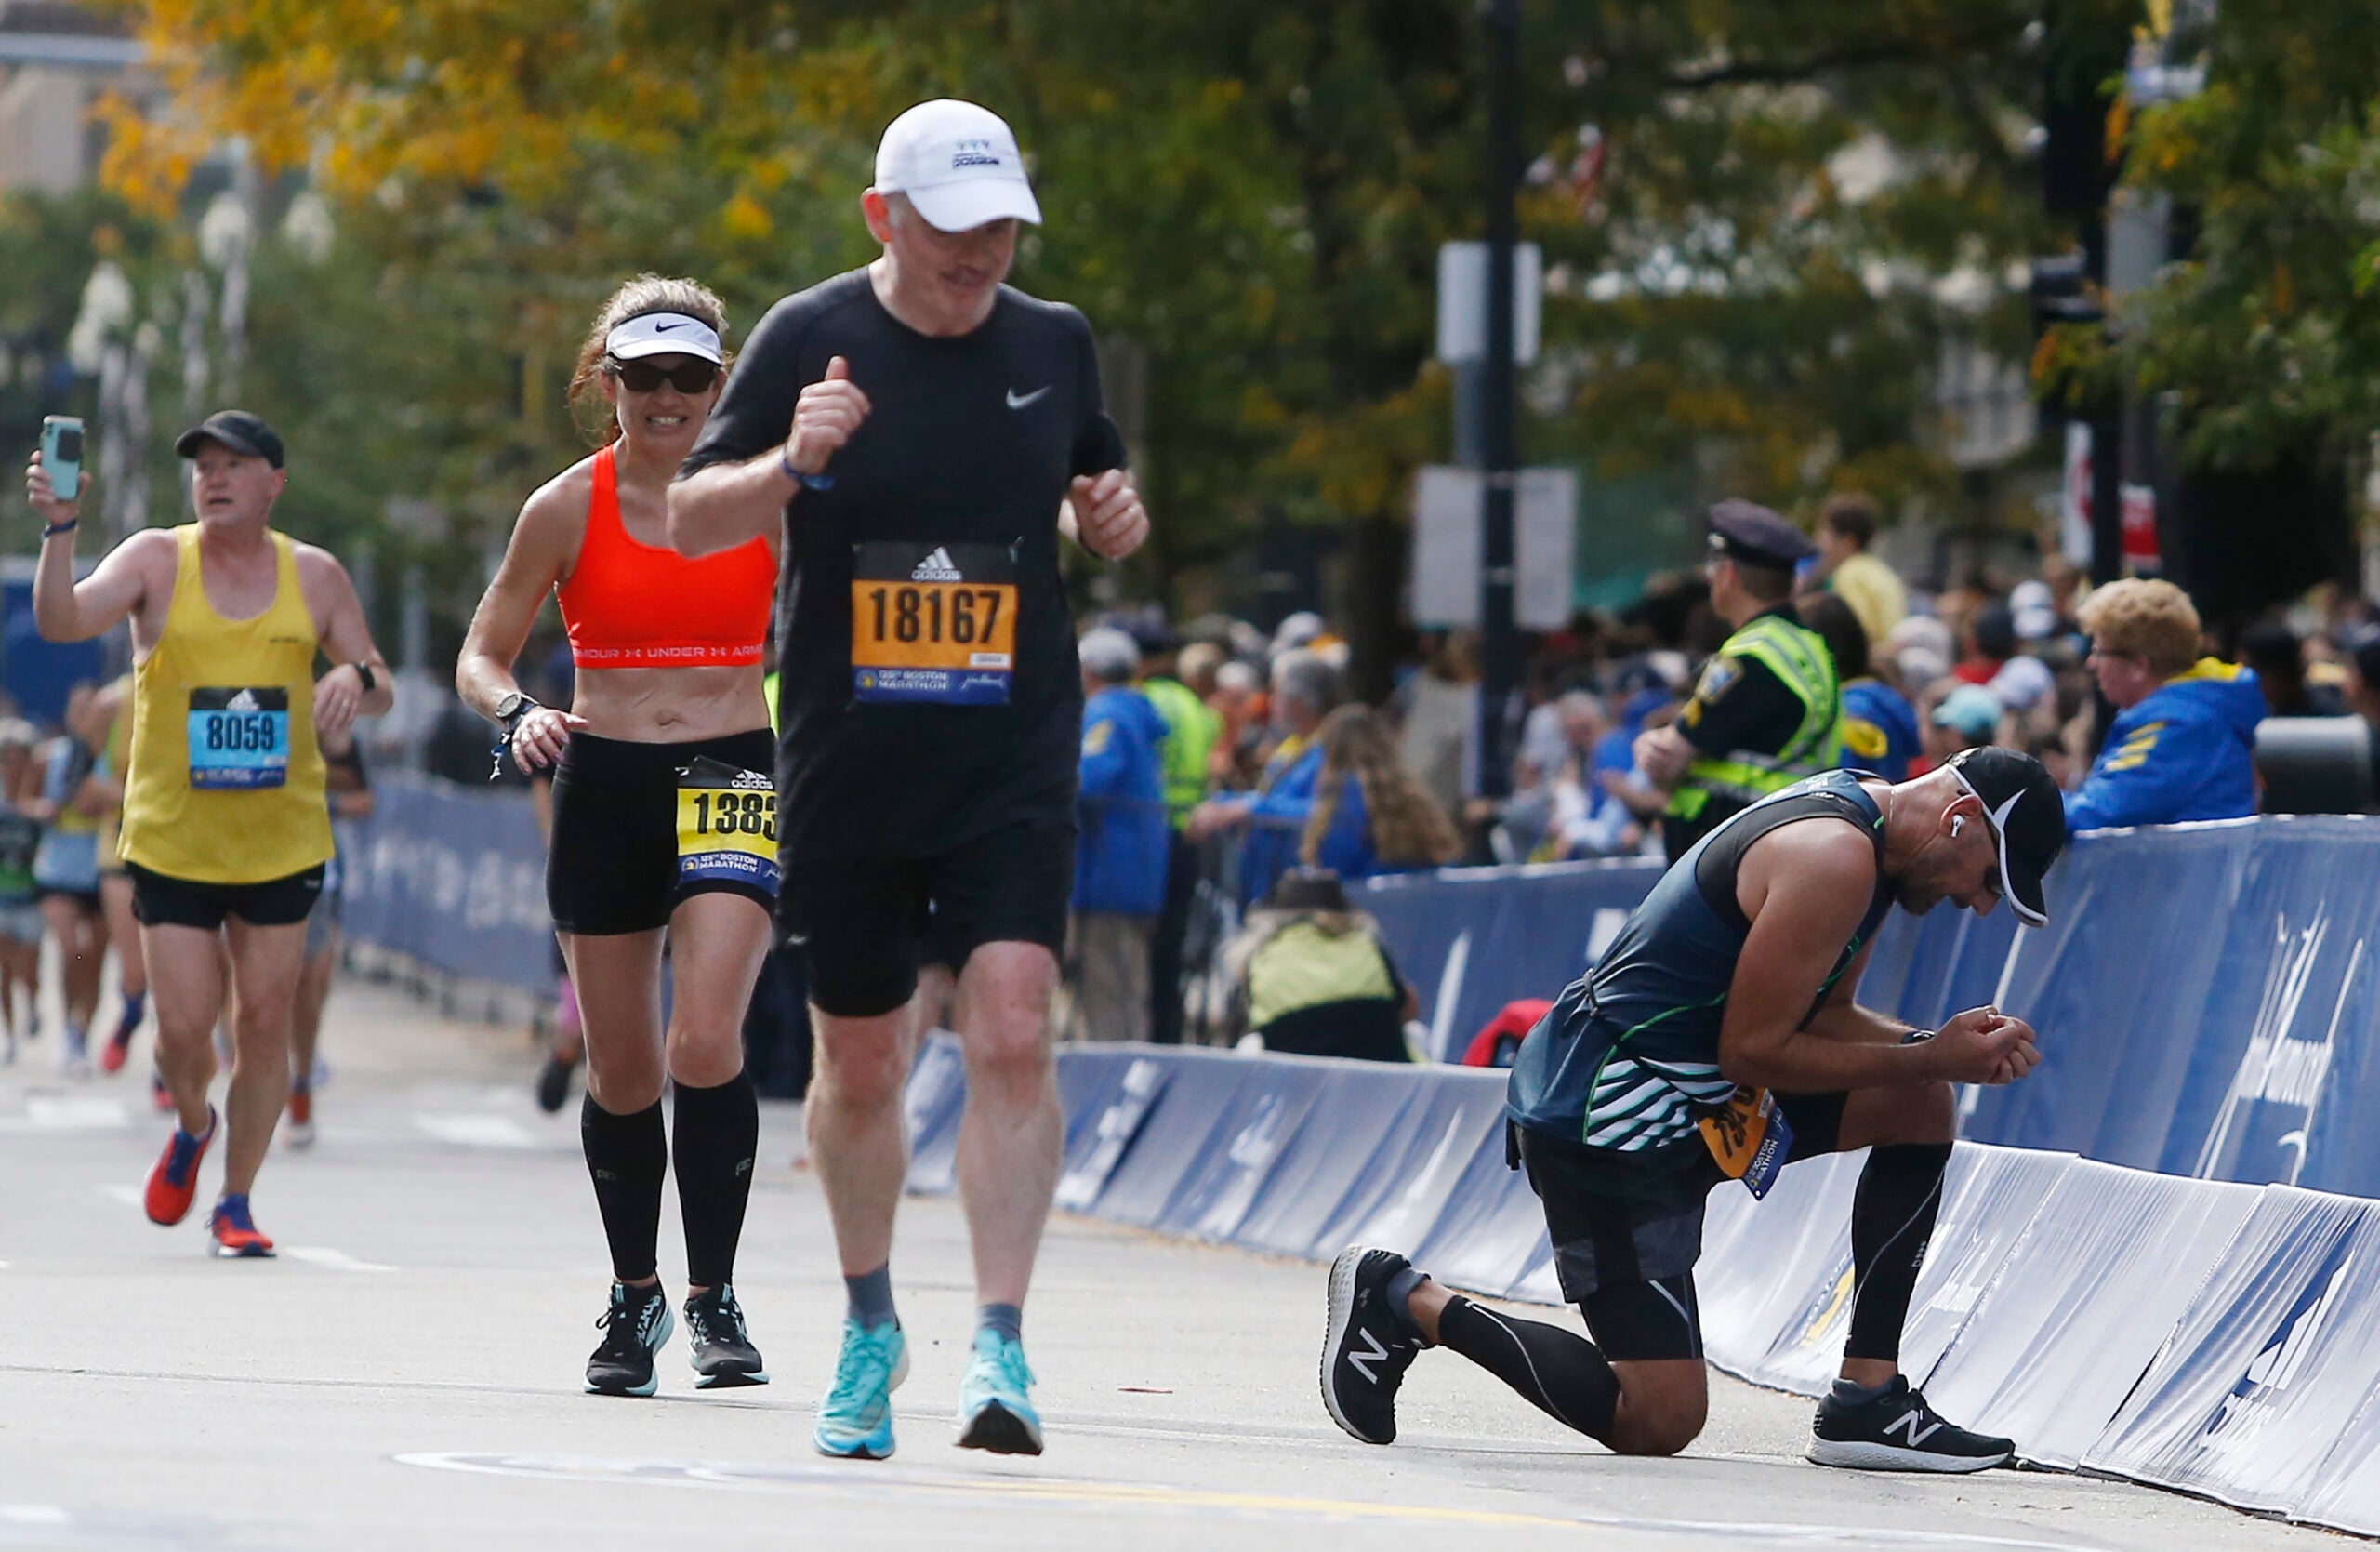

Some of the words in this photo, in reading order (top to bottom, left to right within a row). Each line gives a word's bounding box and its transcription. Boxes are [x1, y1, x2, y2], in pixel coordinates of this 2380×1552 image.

[911, 568, 963, 582] adidas
[870, 587, 1002, 644] 18167
[647, 646, 705, 658] UNDER
[903, 670, 949, 681] BOSTON
[878, 679, 949, 691] MARATHON
[206, 713, 274, 751] 8059
[731, 779, 774, 789] adidas
[699, 859, 759, 873] MARATHON
[720, 853, 758, 866] BOSTON
